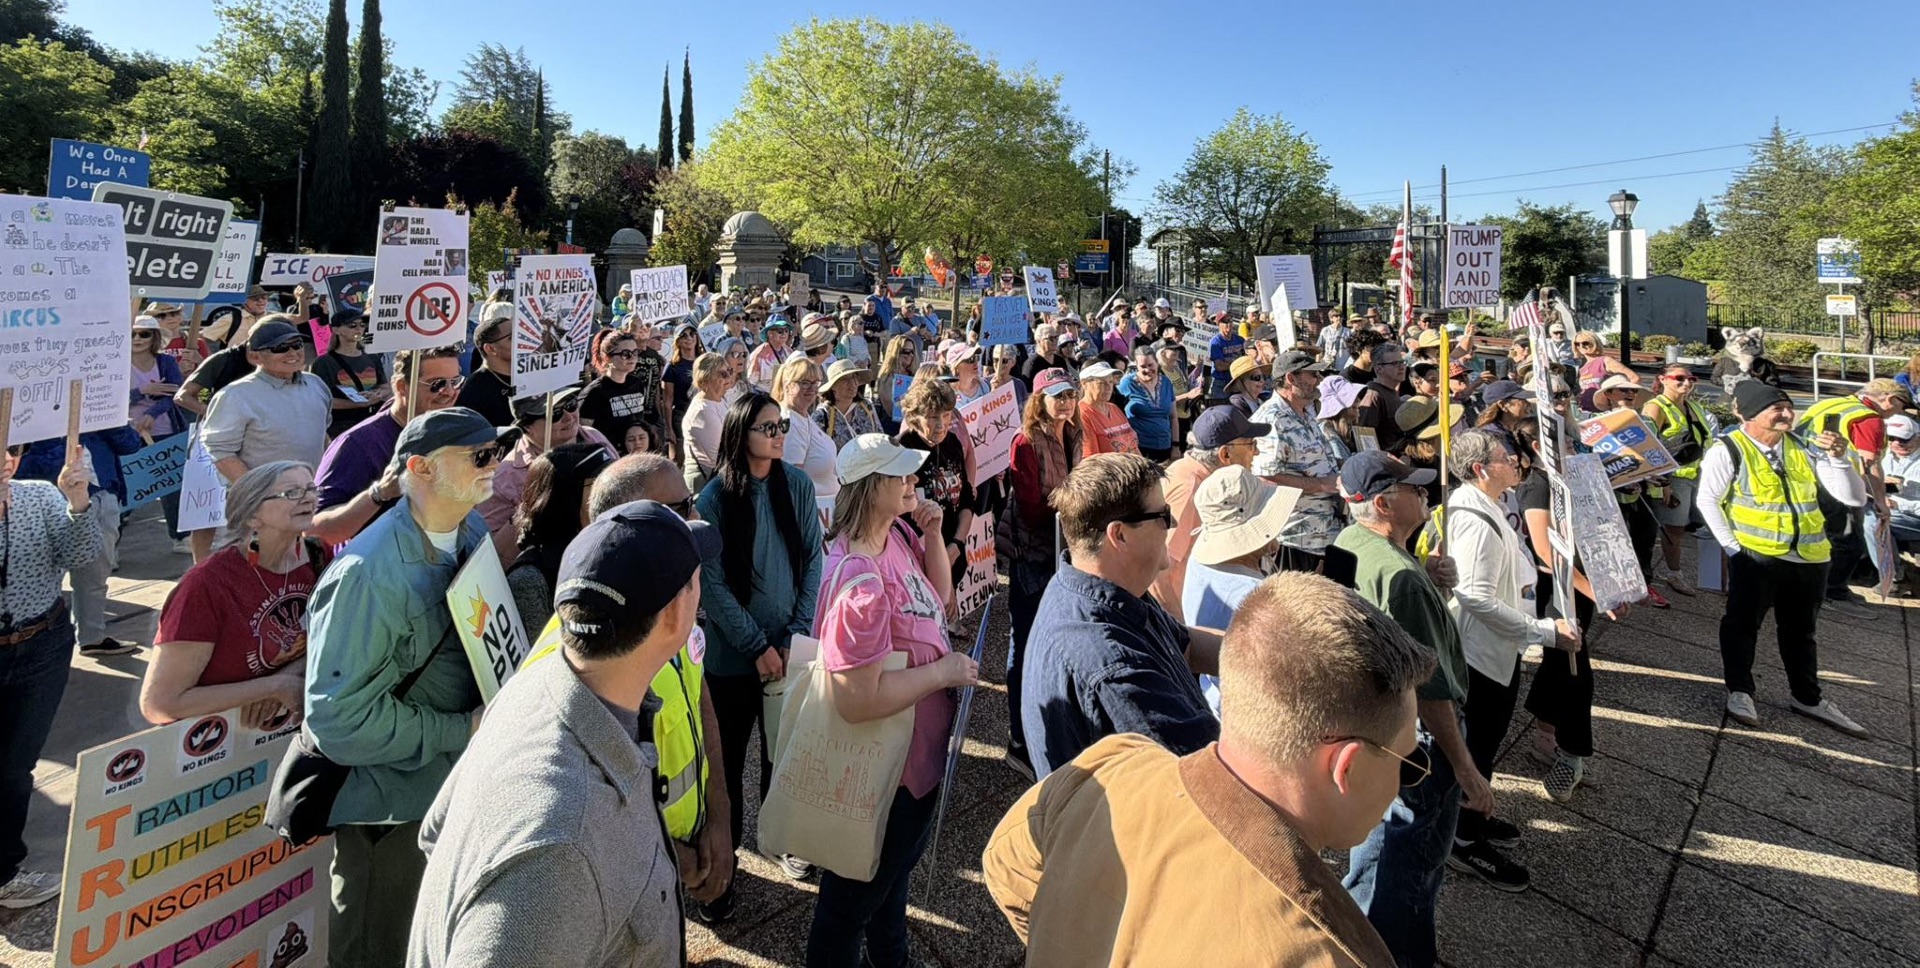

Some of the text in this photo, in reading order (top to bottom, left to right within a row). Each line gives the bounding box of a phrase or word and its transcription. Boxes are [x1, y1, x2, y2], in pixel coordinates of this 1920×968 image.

[70, 145, 136, 164] We Once
[81, 161, 128, 178] Had A
[64, 212, 116, 227] moves
[159, 208, 218, 237] right
[411, 217, 424, 225] SHE
[410, 227, 425, 235] HAD
[1452, 229, 1500, 246] TRUMP
[32, 231, 57, 250] he
[13, 256, 91, 276] a The
[1456, 251, 1493, 268] OUT
[271, 258, 344, 283] ICE OUT
[402, 269, 418, 277] CELL
[536, 269, 551, 280] NO
[1455, 271, 1491, 287] AND
[217, 282, 245, 292] asap
[634, 268, 684, 292] DEMOCRACY
[64, 287, 76, 300] a
[379, 295, 403, 305] THEY
[649, 289, 669, 302] NOT
[1036, 287, 1049, 296] NO
[1450, 290, 1500, 305] CRONIES
[418, 296, 451, 321] ICE
[1031, 298, 1057, 307] KINGS
[378, 308, 398, 318] HAD
[377, 320, 408, 331] GUNS!
[34, 336, 68, 355] tiny
[73, 330, 125, 354] greedy
[563, 346, 586, 366] 1776
[20, 376, 63, 411] OFF!
[981, 391, 1013, 415] KINGS
[1612, 429, 1637, 445] ICE
[122, 445, 185, 475] WORLD
[149, 460, 186, 478] THE
[1605, 456, 1635, 474] WAR
[133, 472, 183, 502] TRUMP
[186, 488, 216, 512] NOT
[984, 520, 993, 540] Is
[967, 565, 986, 586] You
[482, 603, 511, 665] NO
[255, 737, 266, 746] NO
[182, 750, 226, 773] NO KINGS
[105, 776, 144, 795] NO KINGS
